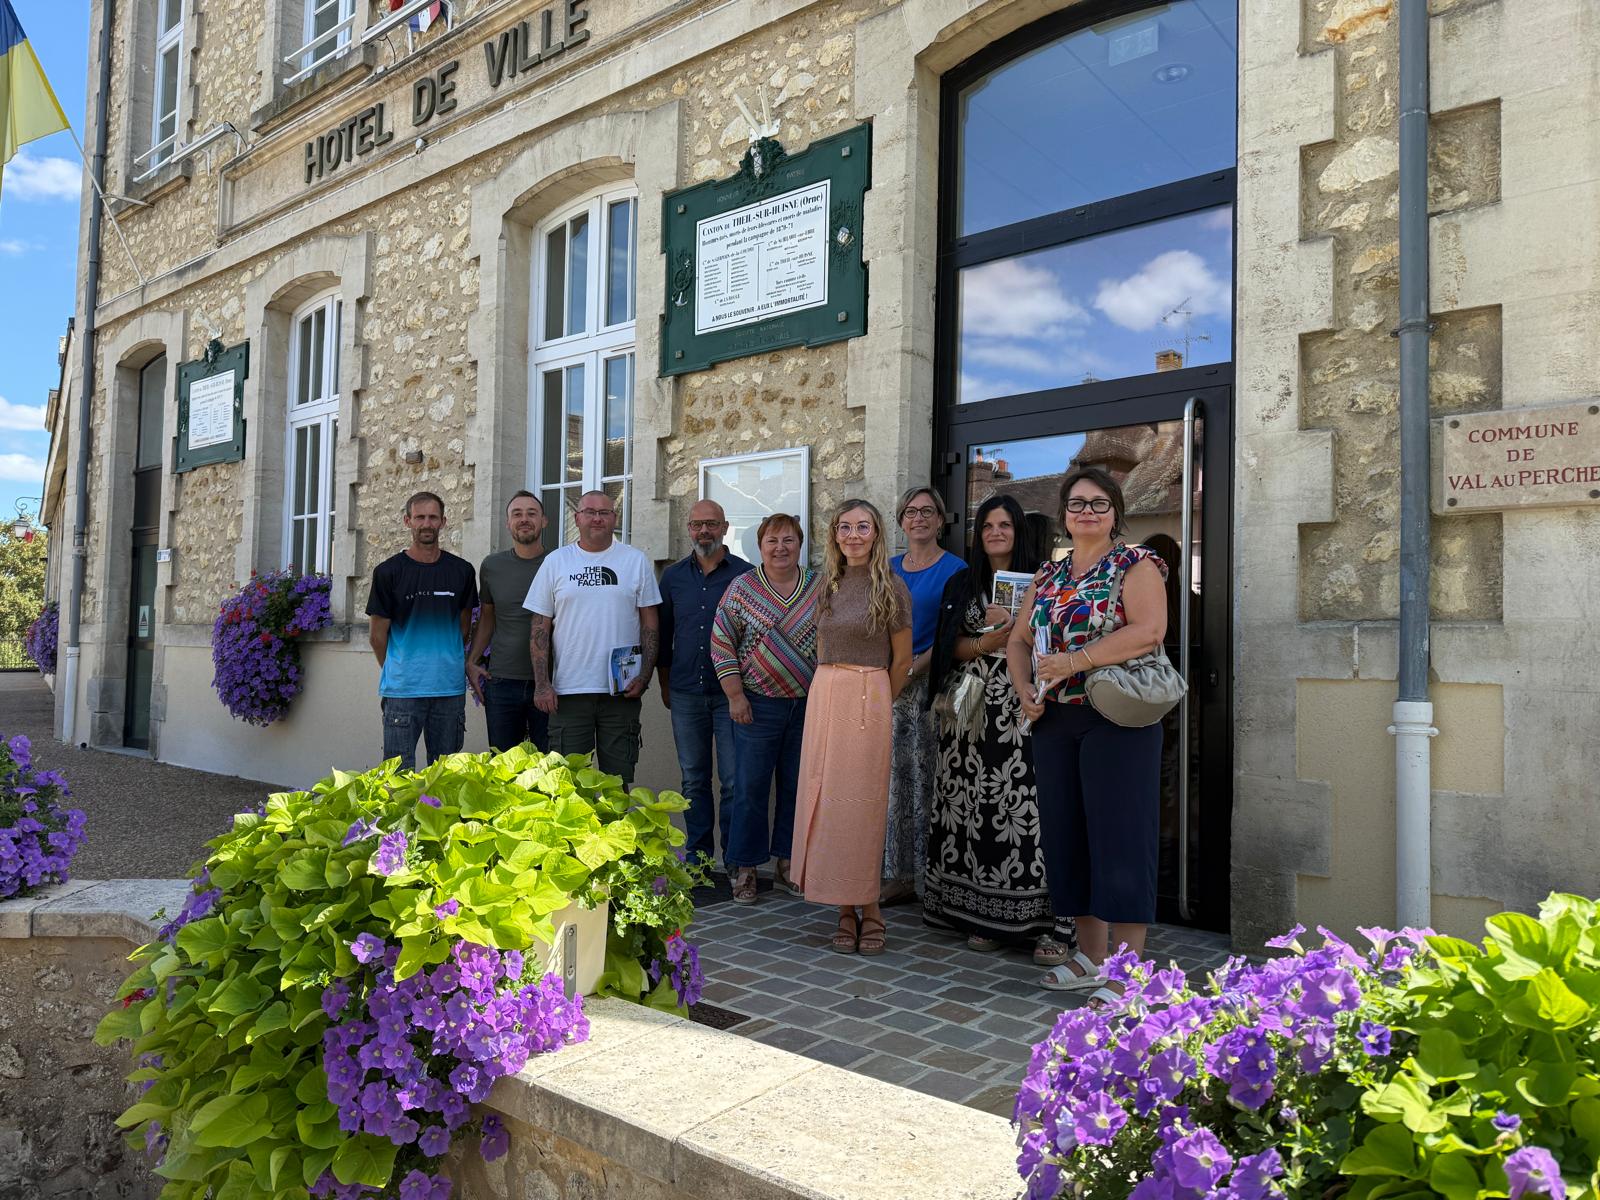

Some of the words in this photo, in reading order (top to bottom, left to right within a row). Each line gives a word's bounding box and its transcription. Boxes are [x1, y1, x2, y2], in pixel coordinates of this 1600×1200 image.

[304, 102, 393, 183] HOTEL
[412, 60, 458, 126] DE
[484, 0, 590, 87] VILLE
[800, 190, 822, 207] (Orne)
[715, 312, 726, 320] NOUS
[1468, 422, 1579, 443] COMMUNE
[1506, 448, 1535, 462] DE
[1448, 474, 1487, 490] VAL
[1491, 474, 1515, 488] AU
[1518, 466, 1600, 486] PERCHE
[570, 573, 600, 581] NORTH
